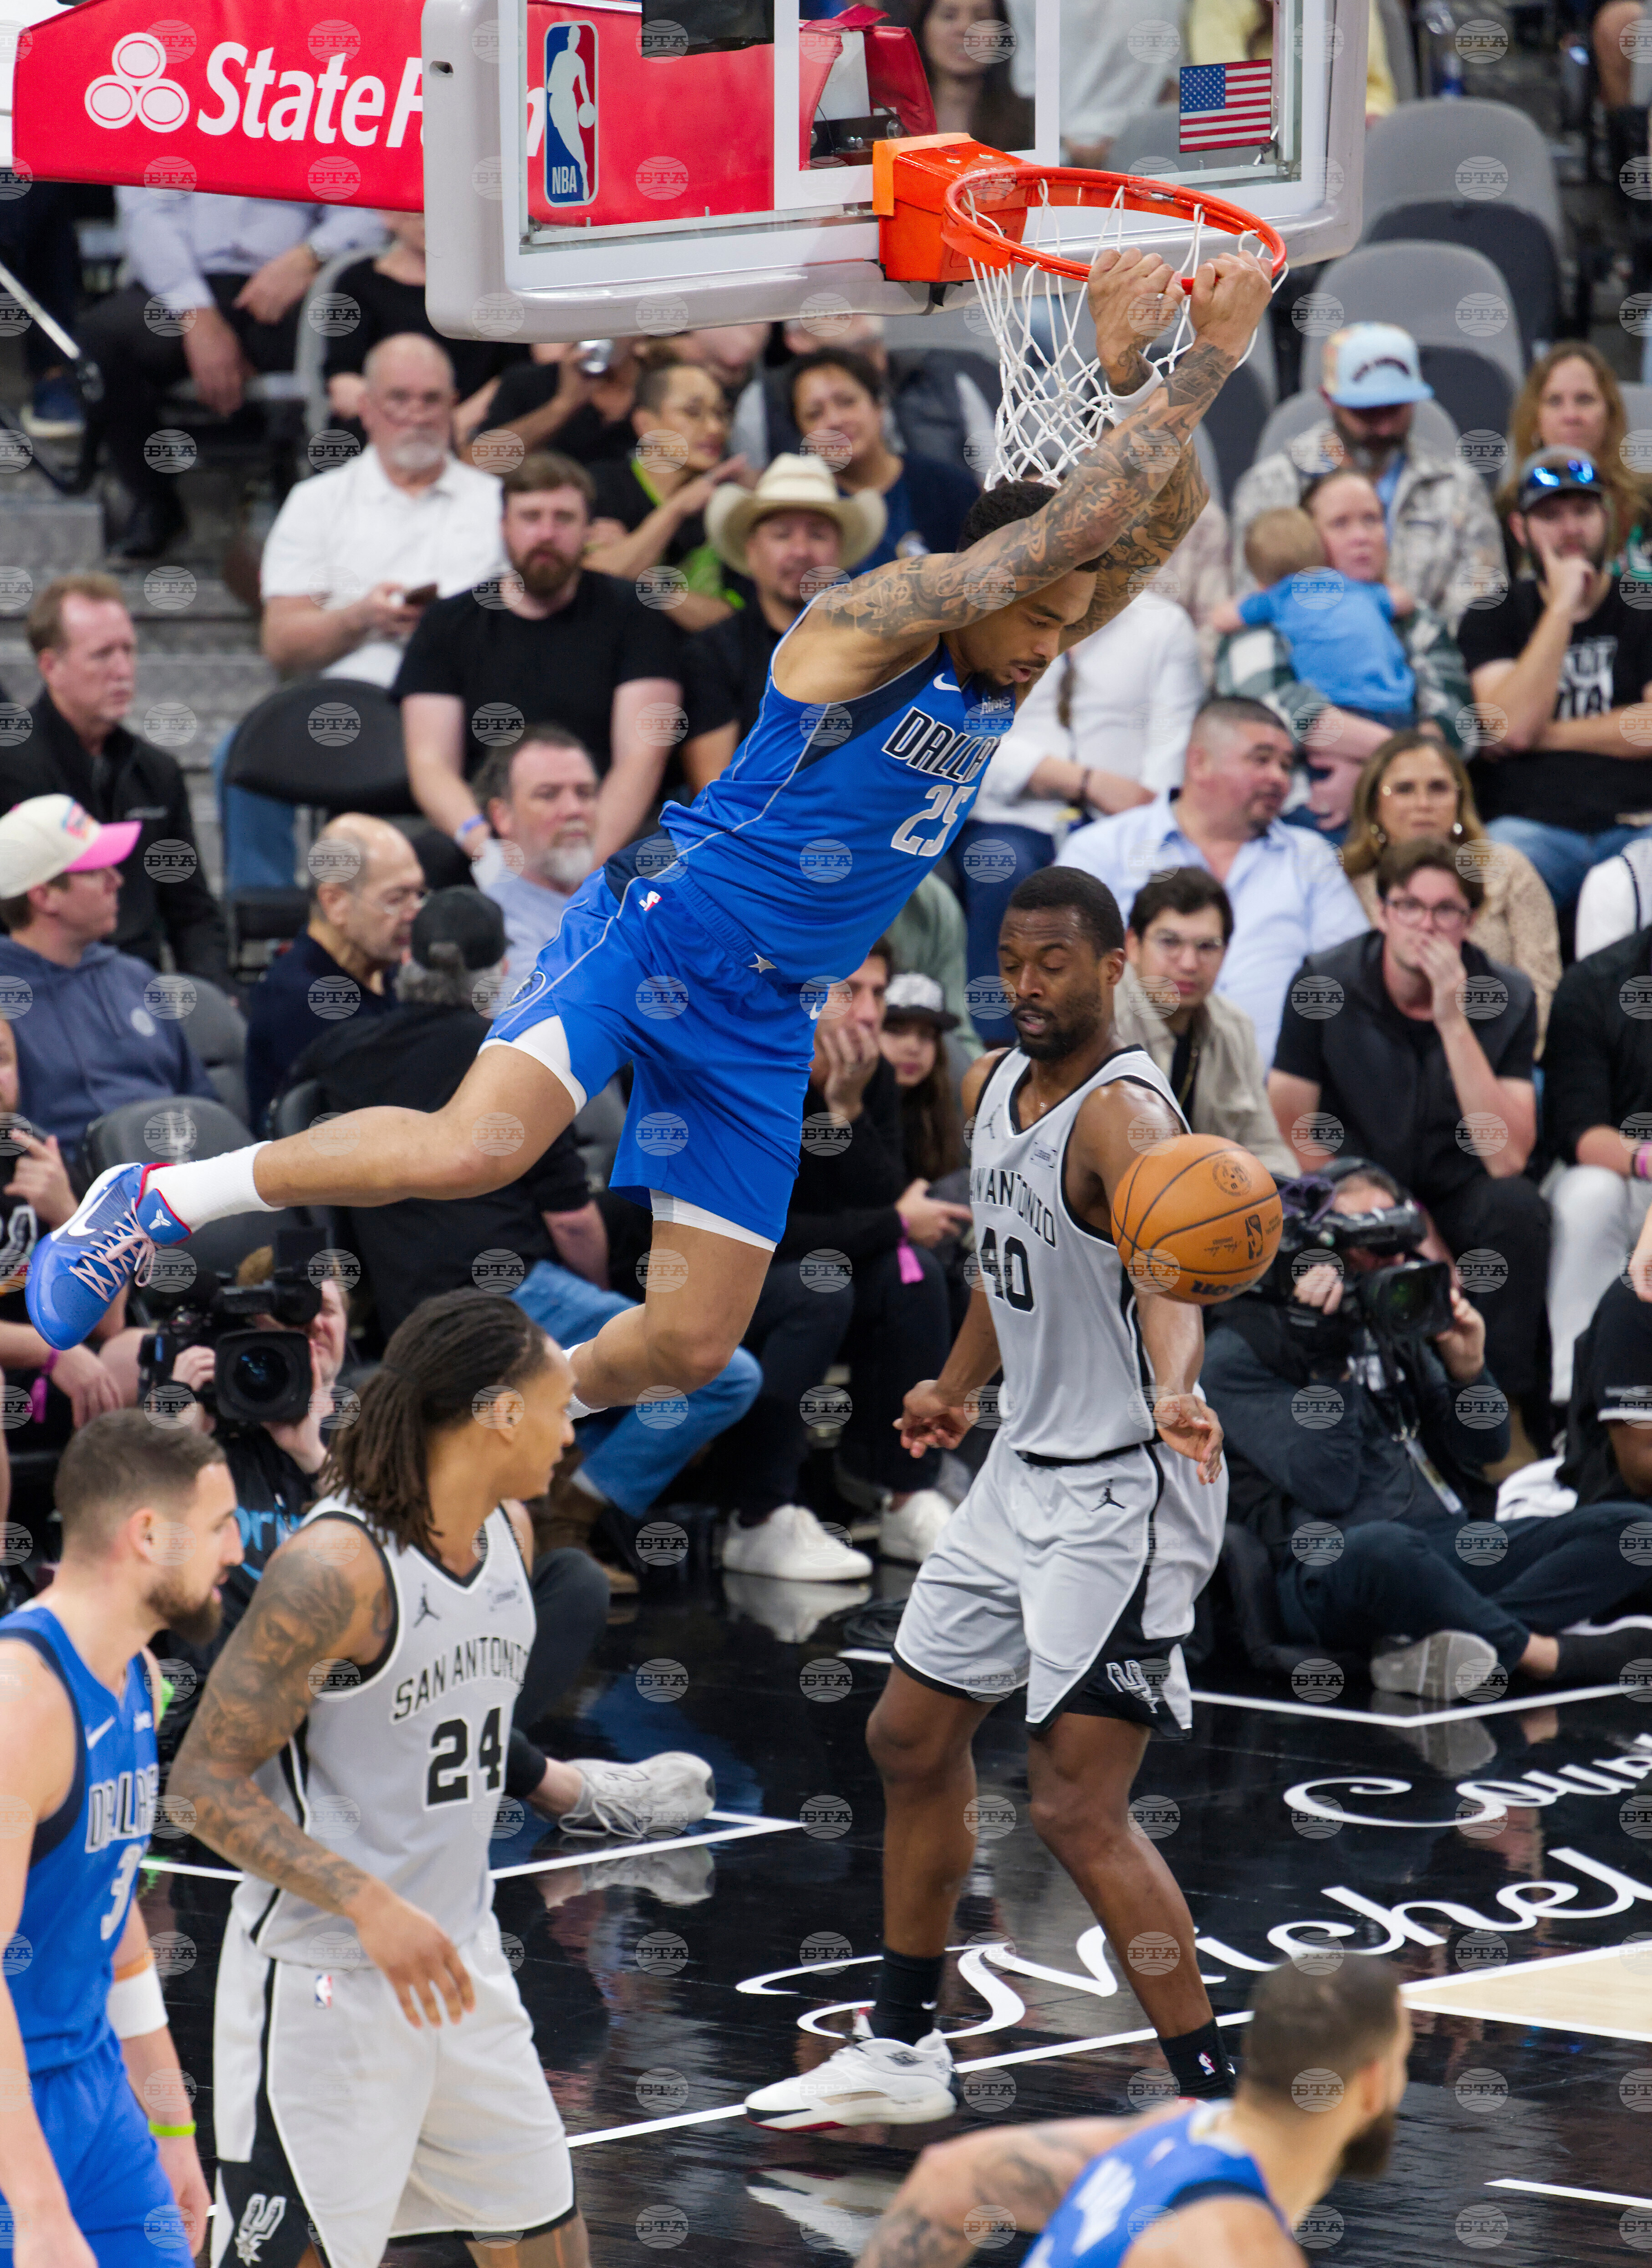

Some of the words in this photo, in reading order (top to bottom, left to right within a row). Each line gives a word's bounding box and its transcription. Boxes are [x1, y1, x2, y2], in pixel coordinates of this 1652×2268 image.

[196, 41, 386, 147] State
[552, 165, 577, 194] NBA
[881, 706, 1001, 783] DALLA
[891, 784, 977, 857] 25
[976, 1225, 1037, 1315] 40
[390, 1653, 447, 1725] SAN
[451, 1635, 529, 1686] ANTONI
[423, 1704, 506, 1811] 24
